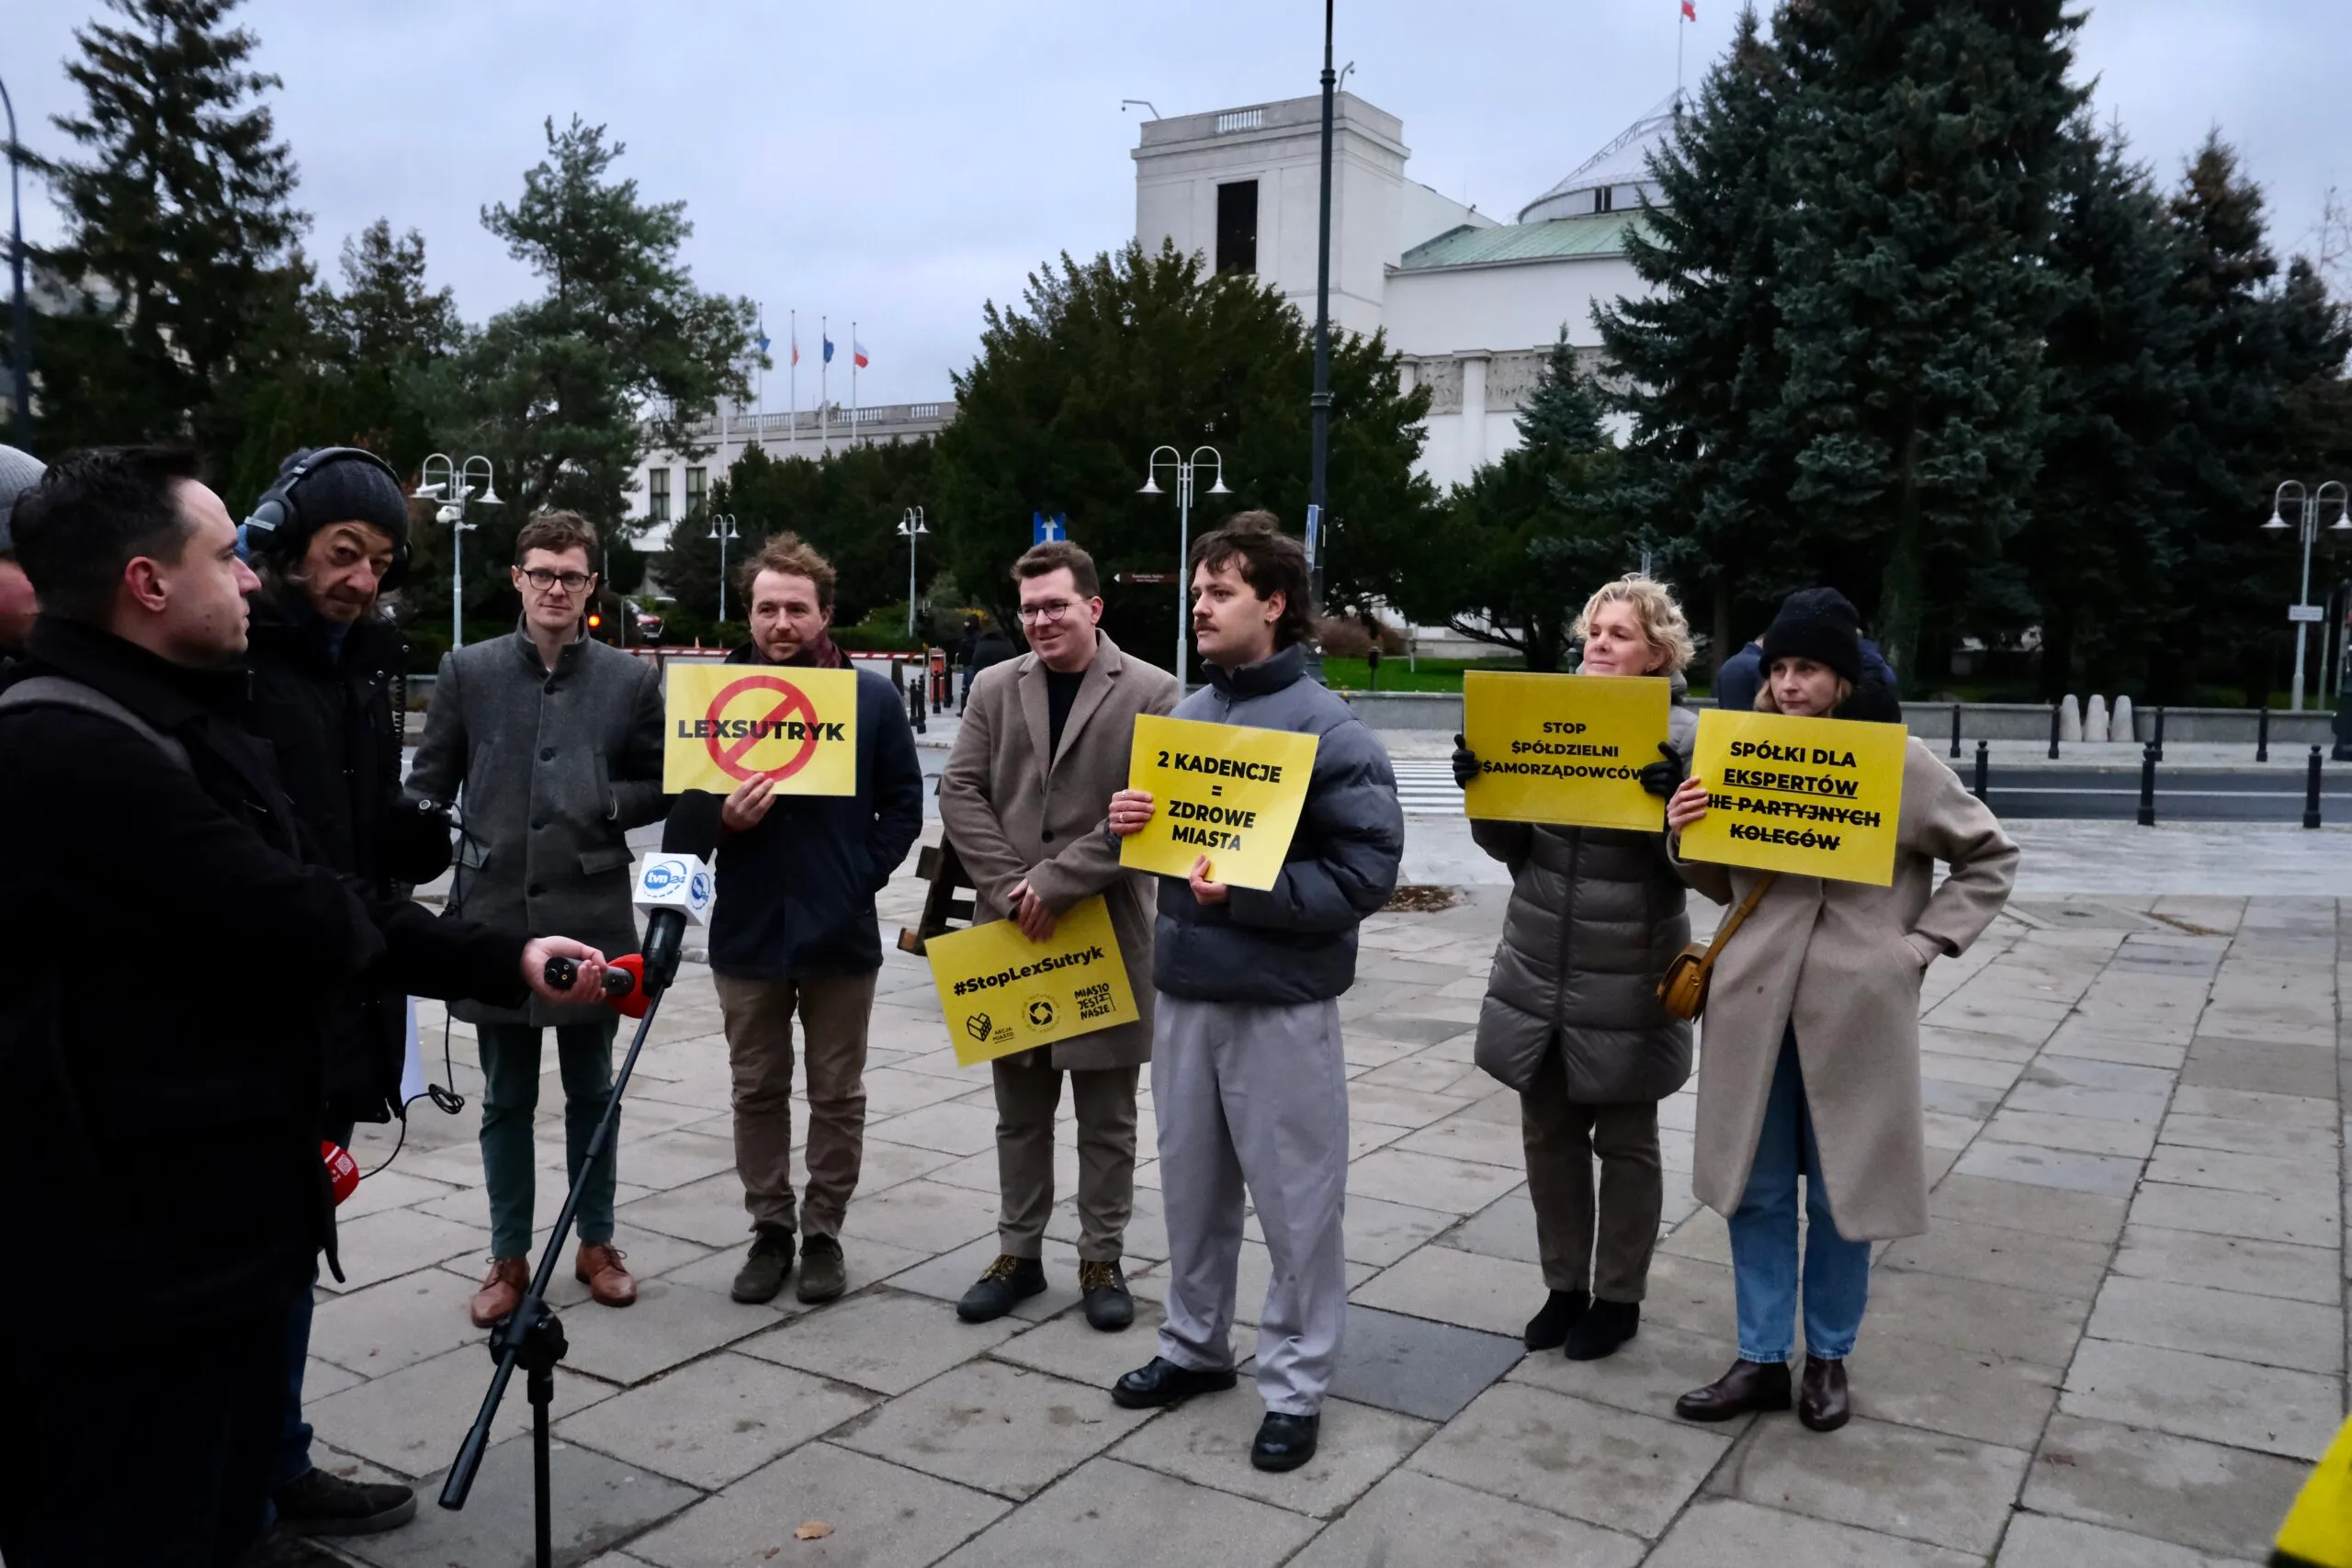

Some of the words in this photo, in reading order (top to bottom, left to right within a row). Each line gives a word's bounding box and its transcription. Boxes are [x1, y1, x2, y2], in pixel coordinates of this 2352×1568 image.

[678, 719, 845, 741] LEXSUTRYK
[1543, 721, 1587, 735] STOP
[1158, 750, 1170, 768] 2
[1174, 753, 1283, 784] KADENCJE
[1730, 740, 1806, 763] SPÓŁKI
[1812, 750, 1857, 768] DLA
[1211, 785, 1223, 796] =
[1724, 768, 1859, 796] EKSPERTÓW
[1168, 800, 1257, 829] ZDROWE
[1738, 796, 1881, 827] PARTYJNYCH
[1171, 824, 1241, 852] MIASTA
[1730, 823, 1840, 851] KOLEGÓW
[954, 946, 1104, 996] #StopLexSutryk
[1074, 983, 1110, 999] MIASTO
[1080, 1004, 1110, 1021] NASZE
